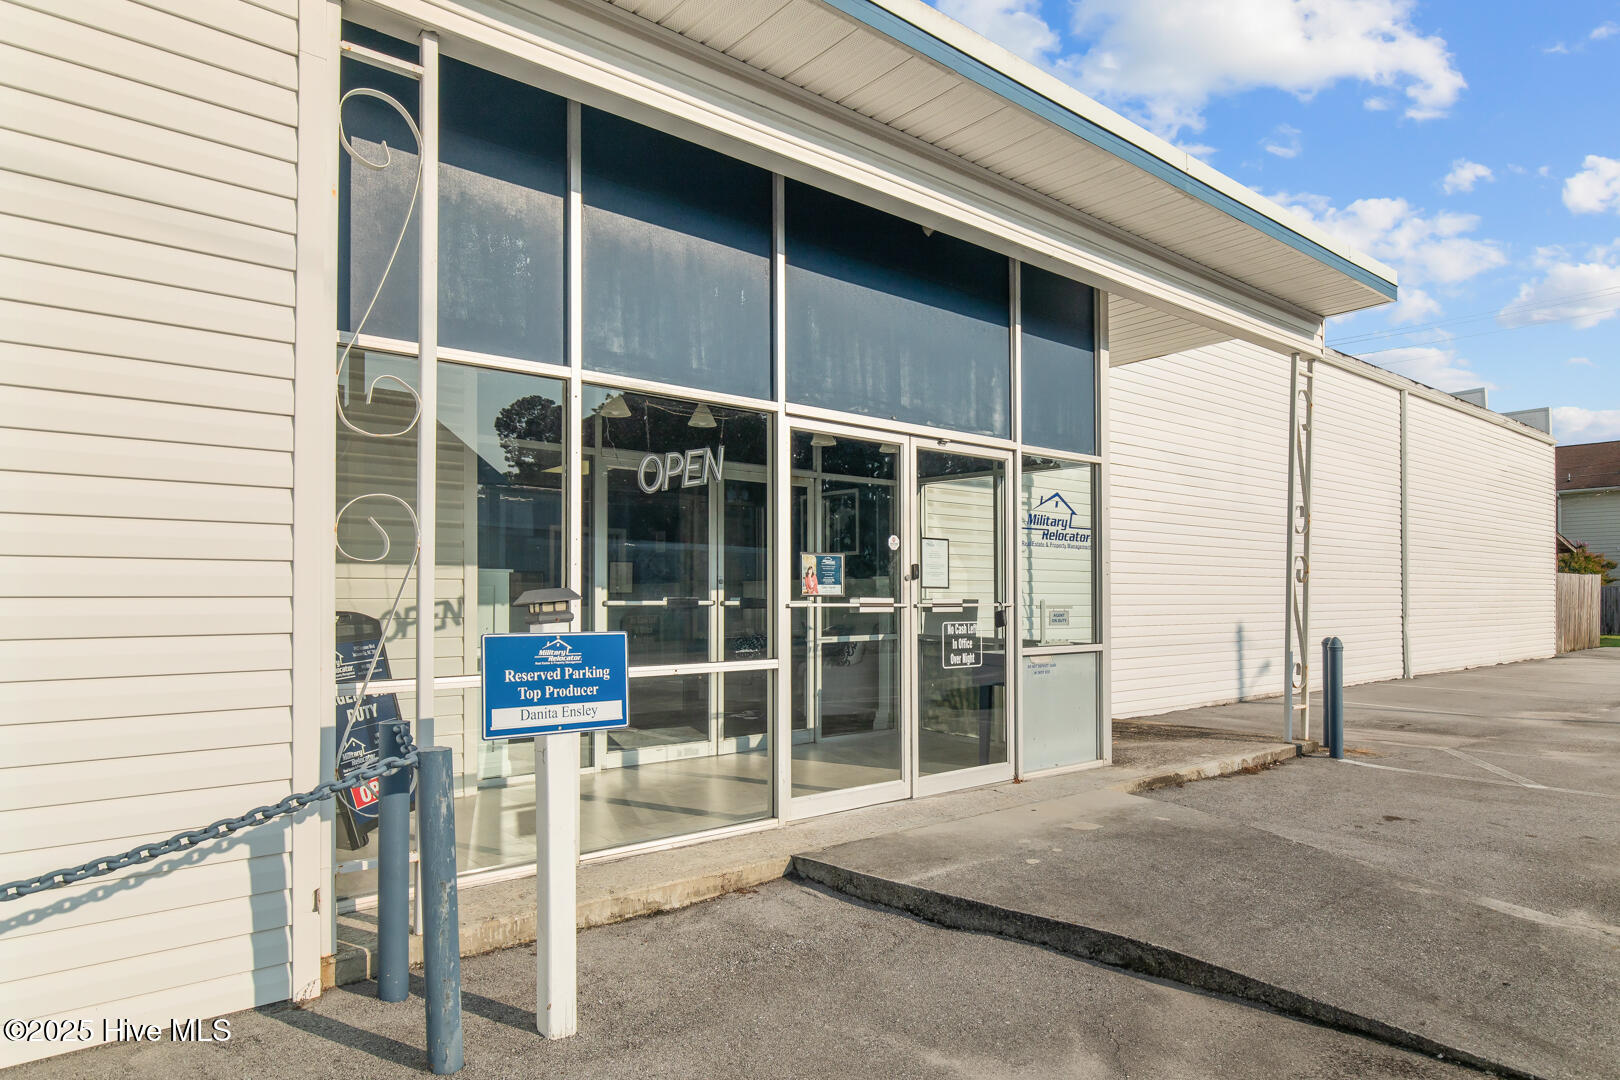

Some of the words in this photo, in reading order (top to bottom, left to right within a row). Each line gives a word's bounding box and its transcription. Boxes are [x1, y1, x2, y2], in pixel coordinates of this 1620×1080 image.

[638, 445, 725, 494] OPEN
[1027, 513, 1068, 530] Military
[1042, 530, 1090, 542] Relocator
[948, 623, 954, 634] No
[955, 623, 967, 634] Cash
[952, 638, 957, 649] In
[958, 638, 972, 649] Office
[950, 653, 961, 664] Over
[962, 652, 975, 666] Night
[504, 668, 560, 682] Reserved
[564, 666, 610, 680] Parking
[518, 687, 541, 702] Top
[545, 685, 598, 698] Producer
[347, 703, 378, 723] DUTY
[520, 708, 558, 721] Danita
[562, 705, 598, 718] Ensley
